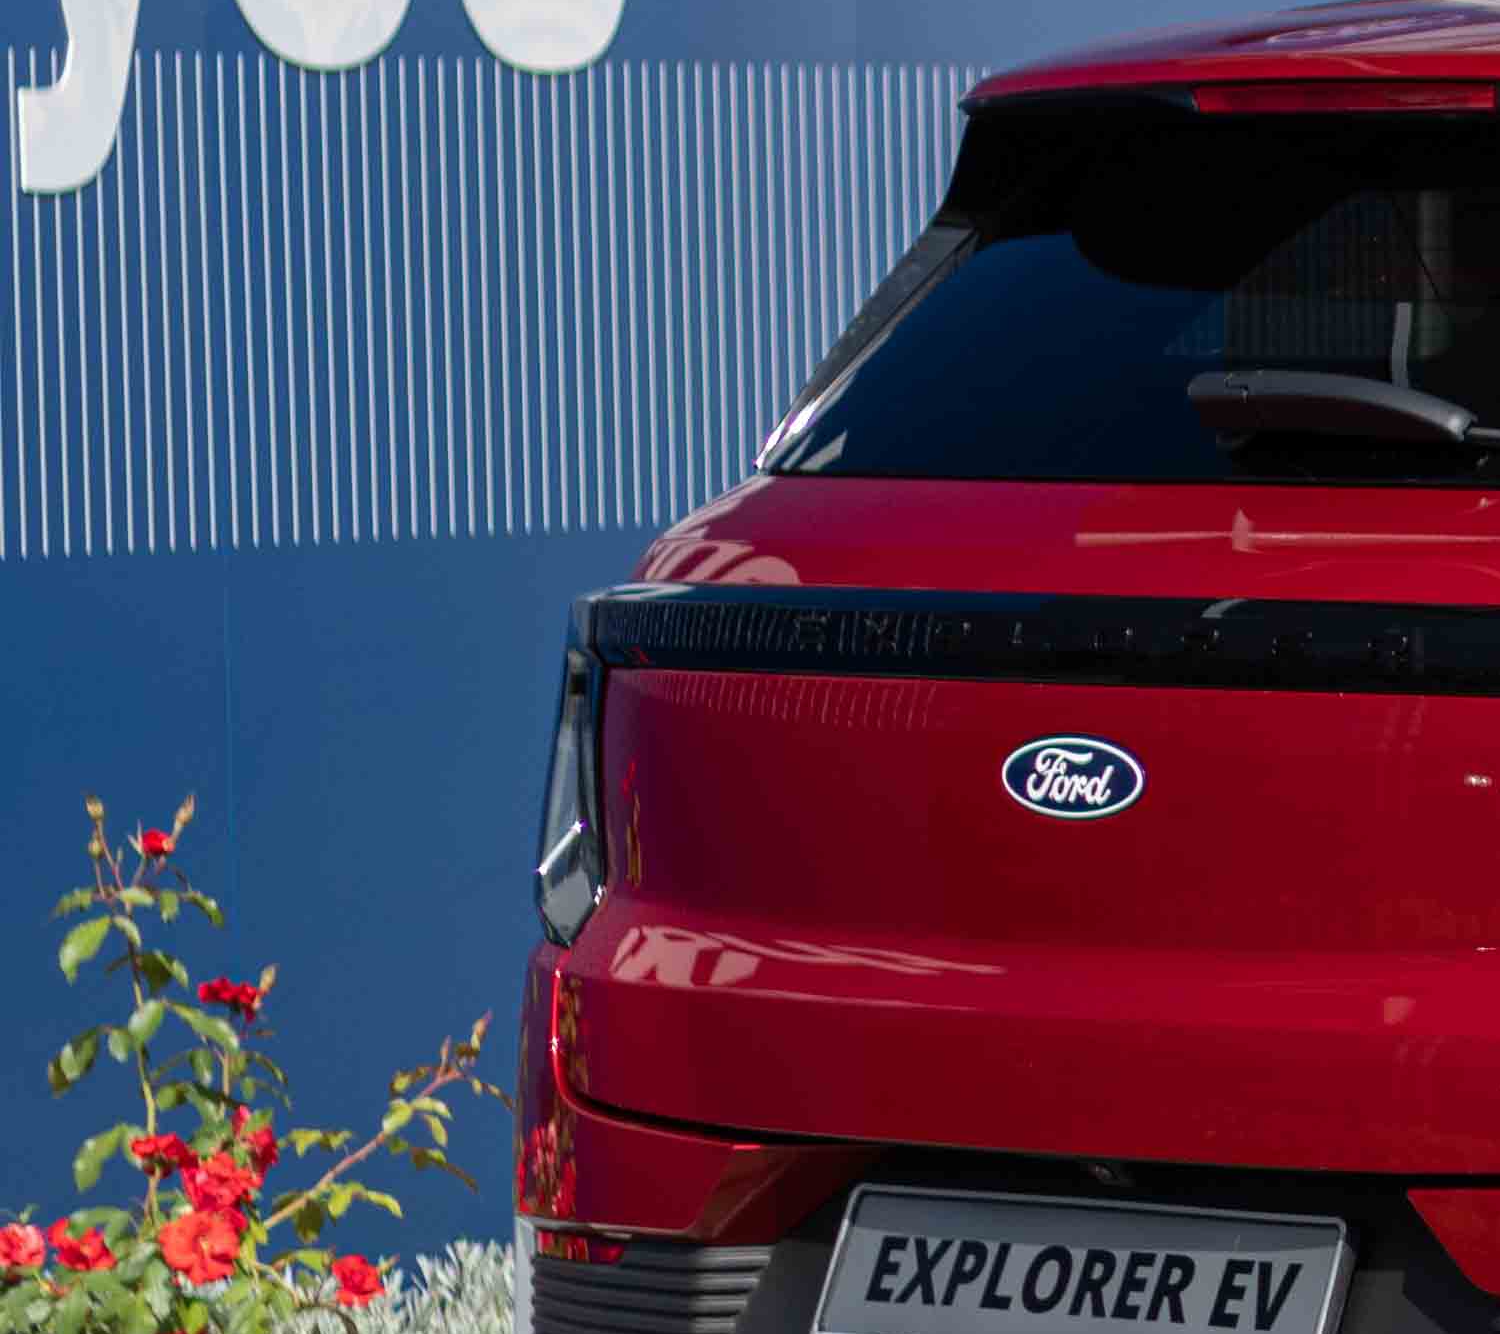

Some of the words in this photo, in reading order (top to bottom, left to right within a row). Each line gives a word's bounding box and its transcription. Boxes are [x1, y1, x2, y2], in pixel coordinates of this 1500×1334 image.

[1026, 747, 1114, 805] Ford
[864, 1235, 1196, 1324] EXPLORER
[1208, 1257, 1303, 1332] EV
